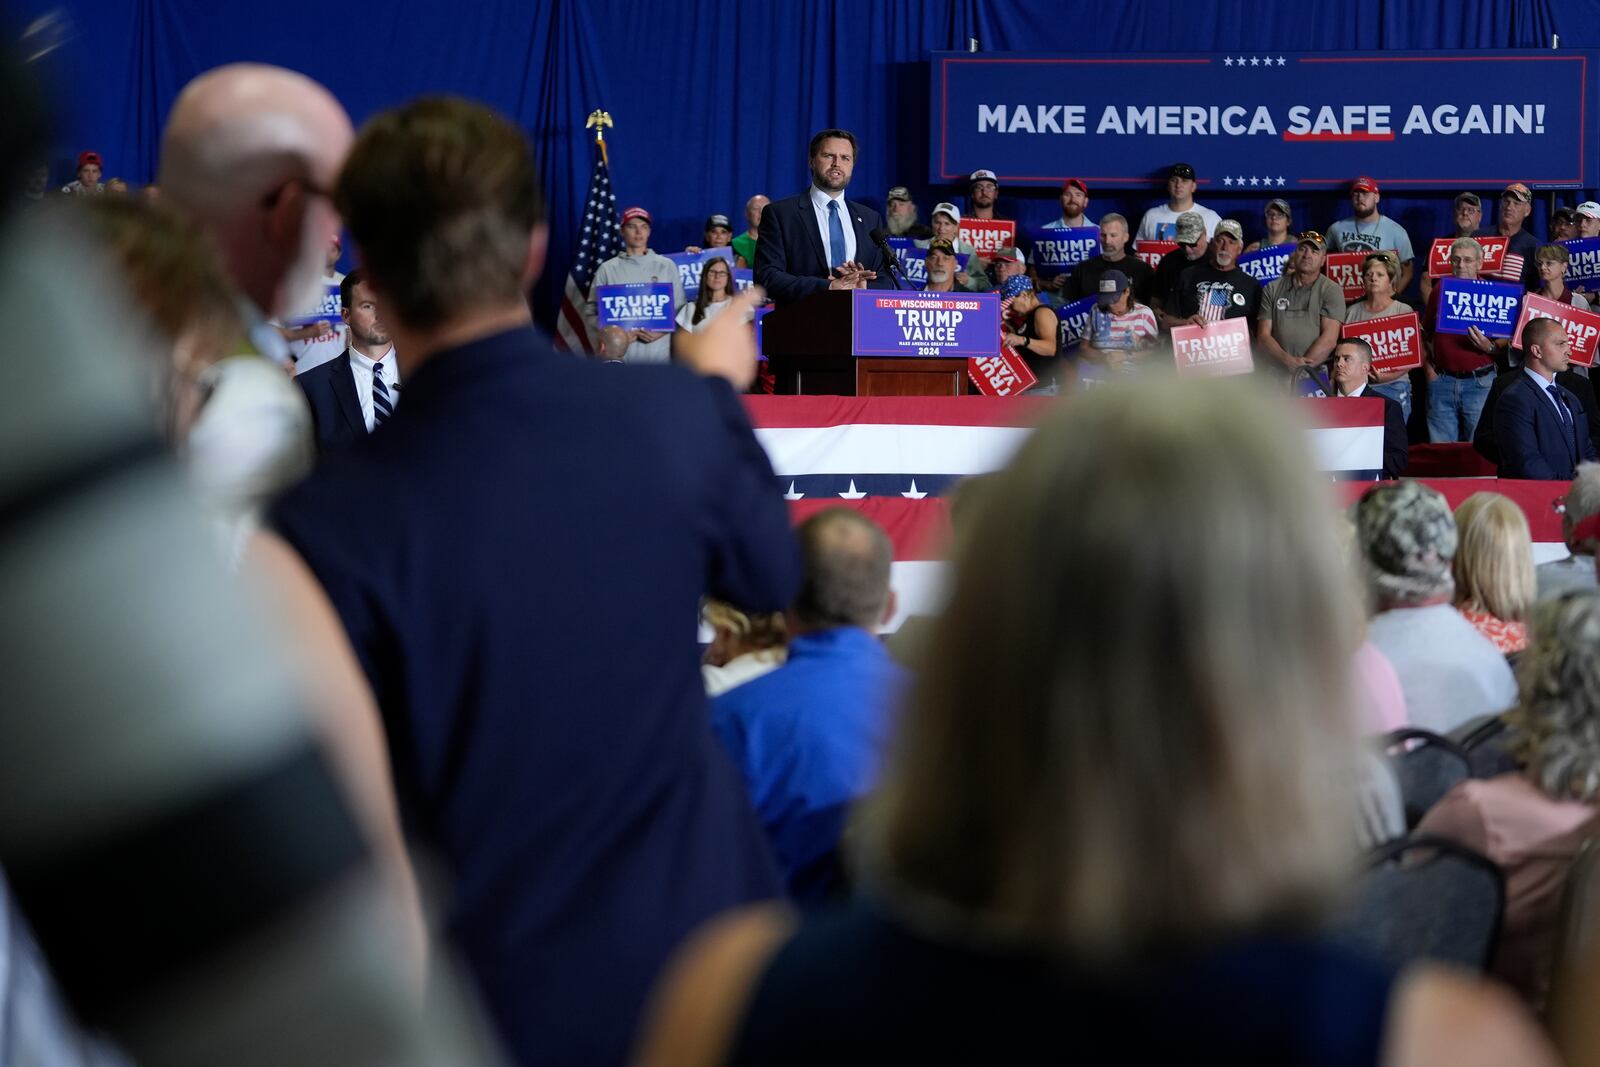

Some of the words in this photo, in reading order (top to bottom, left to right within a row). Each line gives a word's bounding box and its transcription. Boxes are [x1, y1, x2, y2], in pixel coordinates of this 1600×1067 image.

[978, 105, 1086, 133] MAKE
[1096, 105, 1277, 135] AMERICA
[1287, 105, 1391, 135] SAFE
[1402, 104, 1546, 134] AGAIN!
[959, 228, 1011, 241] RUMP
[1035, 238, 1097, 253] TRUMP
[1042, 250, 1090, 262] VANCE
[601, 294, 670, 309] TRUMP
[879, 299, 898, 308] TEXT
[900, 300, 943, 309] WISCONSIN
[944, 301, 955, 309] TO
[955, 301, 978, 310] 88022
[1444, 290, 1518, 310] TRUMP
[610, 306, 664, 318] VANCE
[894, 309, 963, 328] TRUMP
[1452, 303, 1509, 320] VANCE
[902, 326, 956, 341] VANCE
[1177, 332, 1245, 353] TRUMP
[918, 347, 940, 356] 2024
[1187, 345, 1239, 363] VANCE
